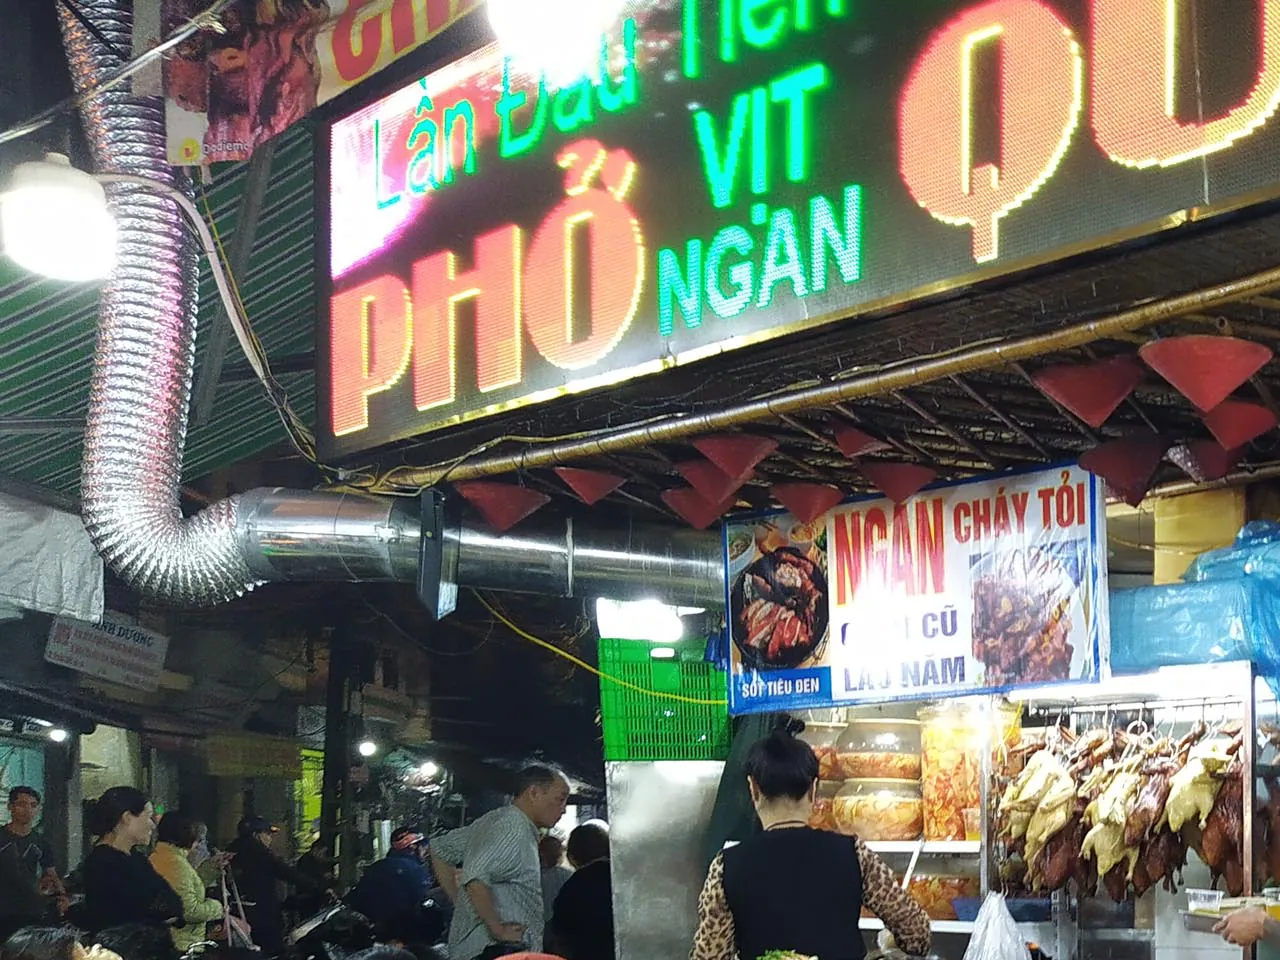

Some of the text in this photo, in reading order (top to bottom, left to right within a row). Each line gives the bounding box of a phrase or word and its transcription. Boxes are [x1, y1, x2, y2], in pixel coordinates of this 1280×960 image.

[375, 77, 476, 210] Lần
[682, 0, 850, 79] Ti
[693, 61, 829, 225] VỊT
[331, 138, 862, 436] PHỞ NGAN
[953, 486, 1030, 545] CHÁY
[1037, 470, 1086, 530] TỎI
[922, 604, 959, 639] CŨ
